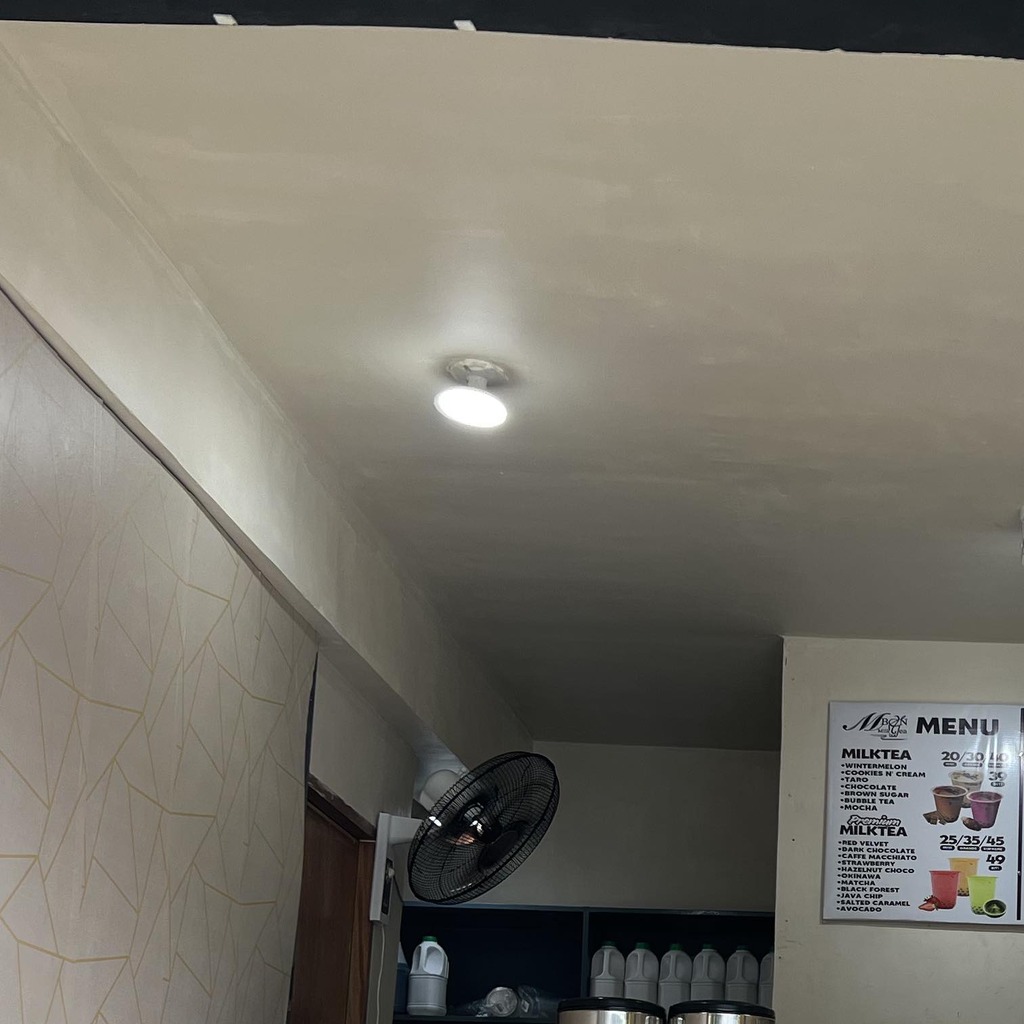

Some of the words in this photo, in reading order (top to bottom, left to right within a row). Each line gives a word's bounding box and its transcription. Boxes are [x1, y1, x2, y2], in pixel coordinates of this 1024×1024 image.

[916, 717, 999, 736] MENU
[842, 749, 911, 760] MILKTEA
[989, 772, 1007, 781] 39
[847, 815, 901, 826] Premium
[840, 825, 907, 836] MILKTEA
[940, 835, 1004, 845] 25/35/45
[986, 855, 1005, 864] 49
